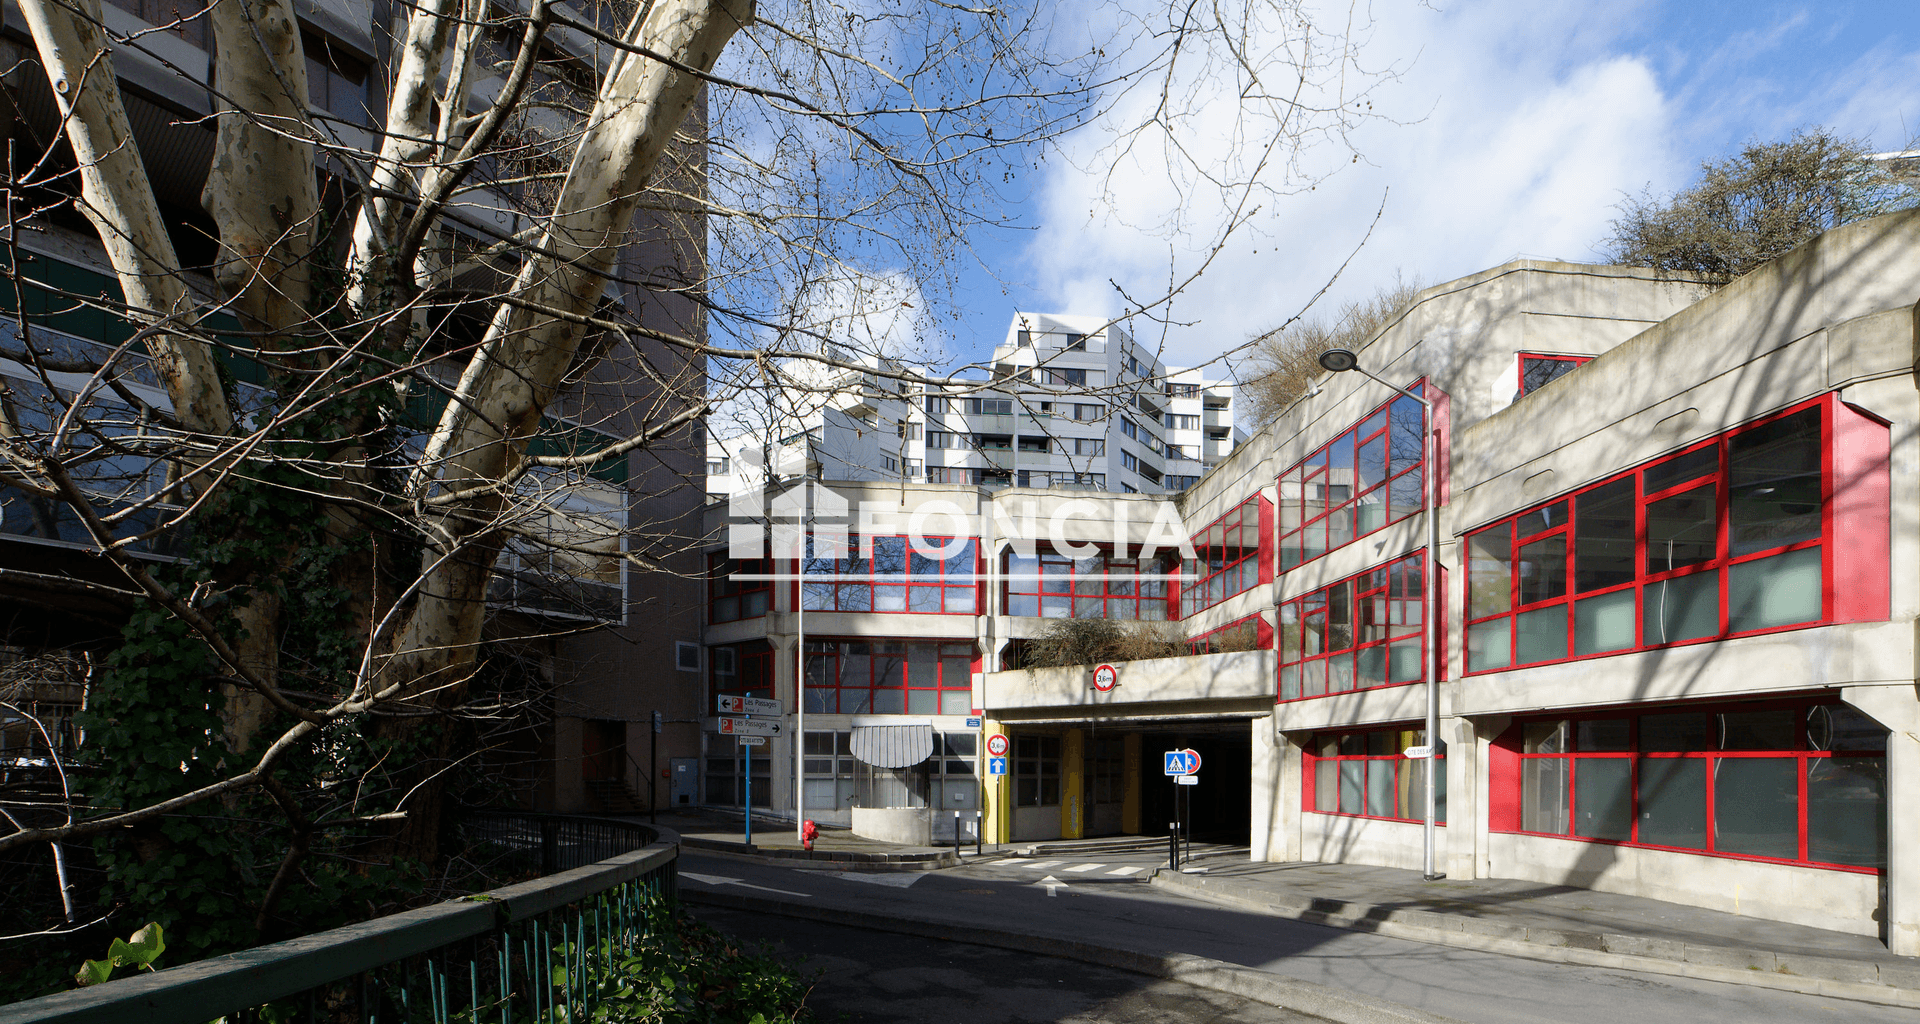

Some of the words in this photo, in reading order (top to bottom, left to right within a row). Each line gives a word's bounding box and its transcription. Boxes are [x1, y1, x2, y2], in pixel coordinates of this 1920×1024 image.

[744, 698, 754, 706] Les
[755, 699, 776, 709] Passages
[745, 720, 767, 729] Passages
